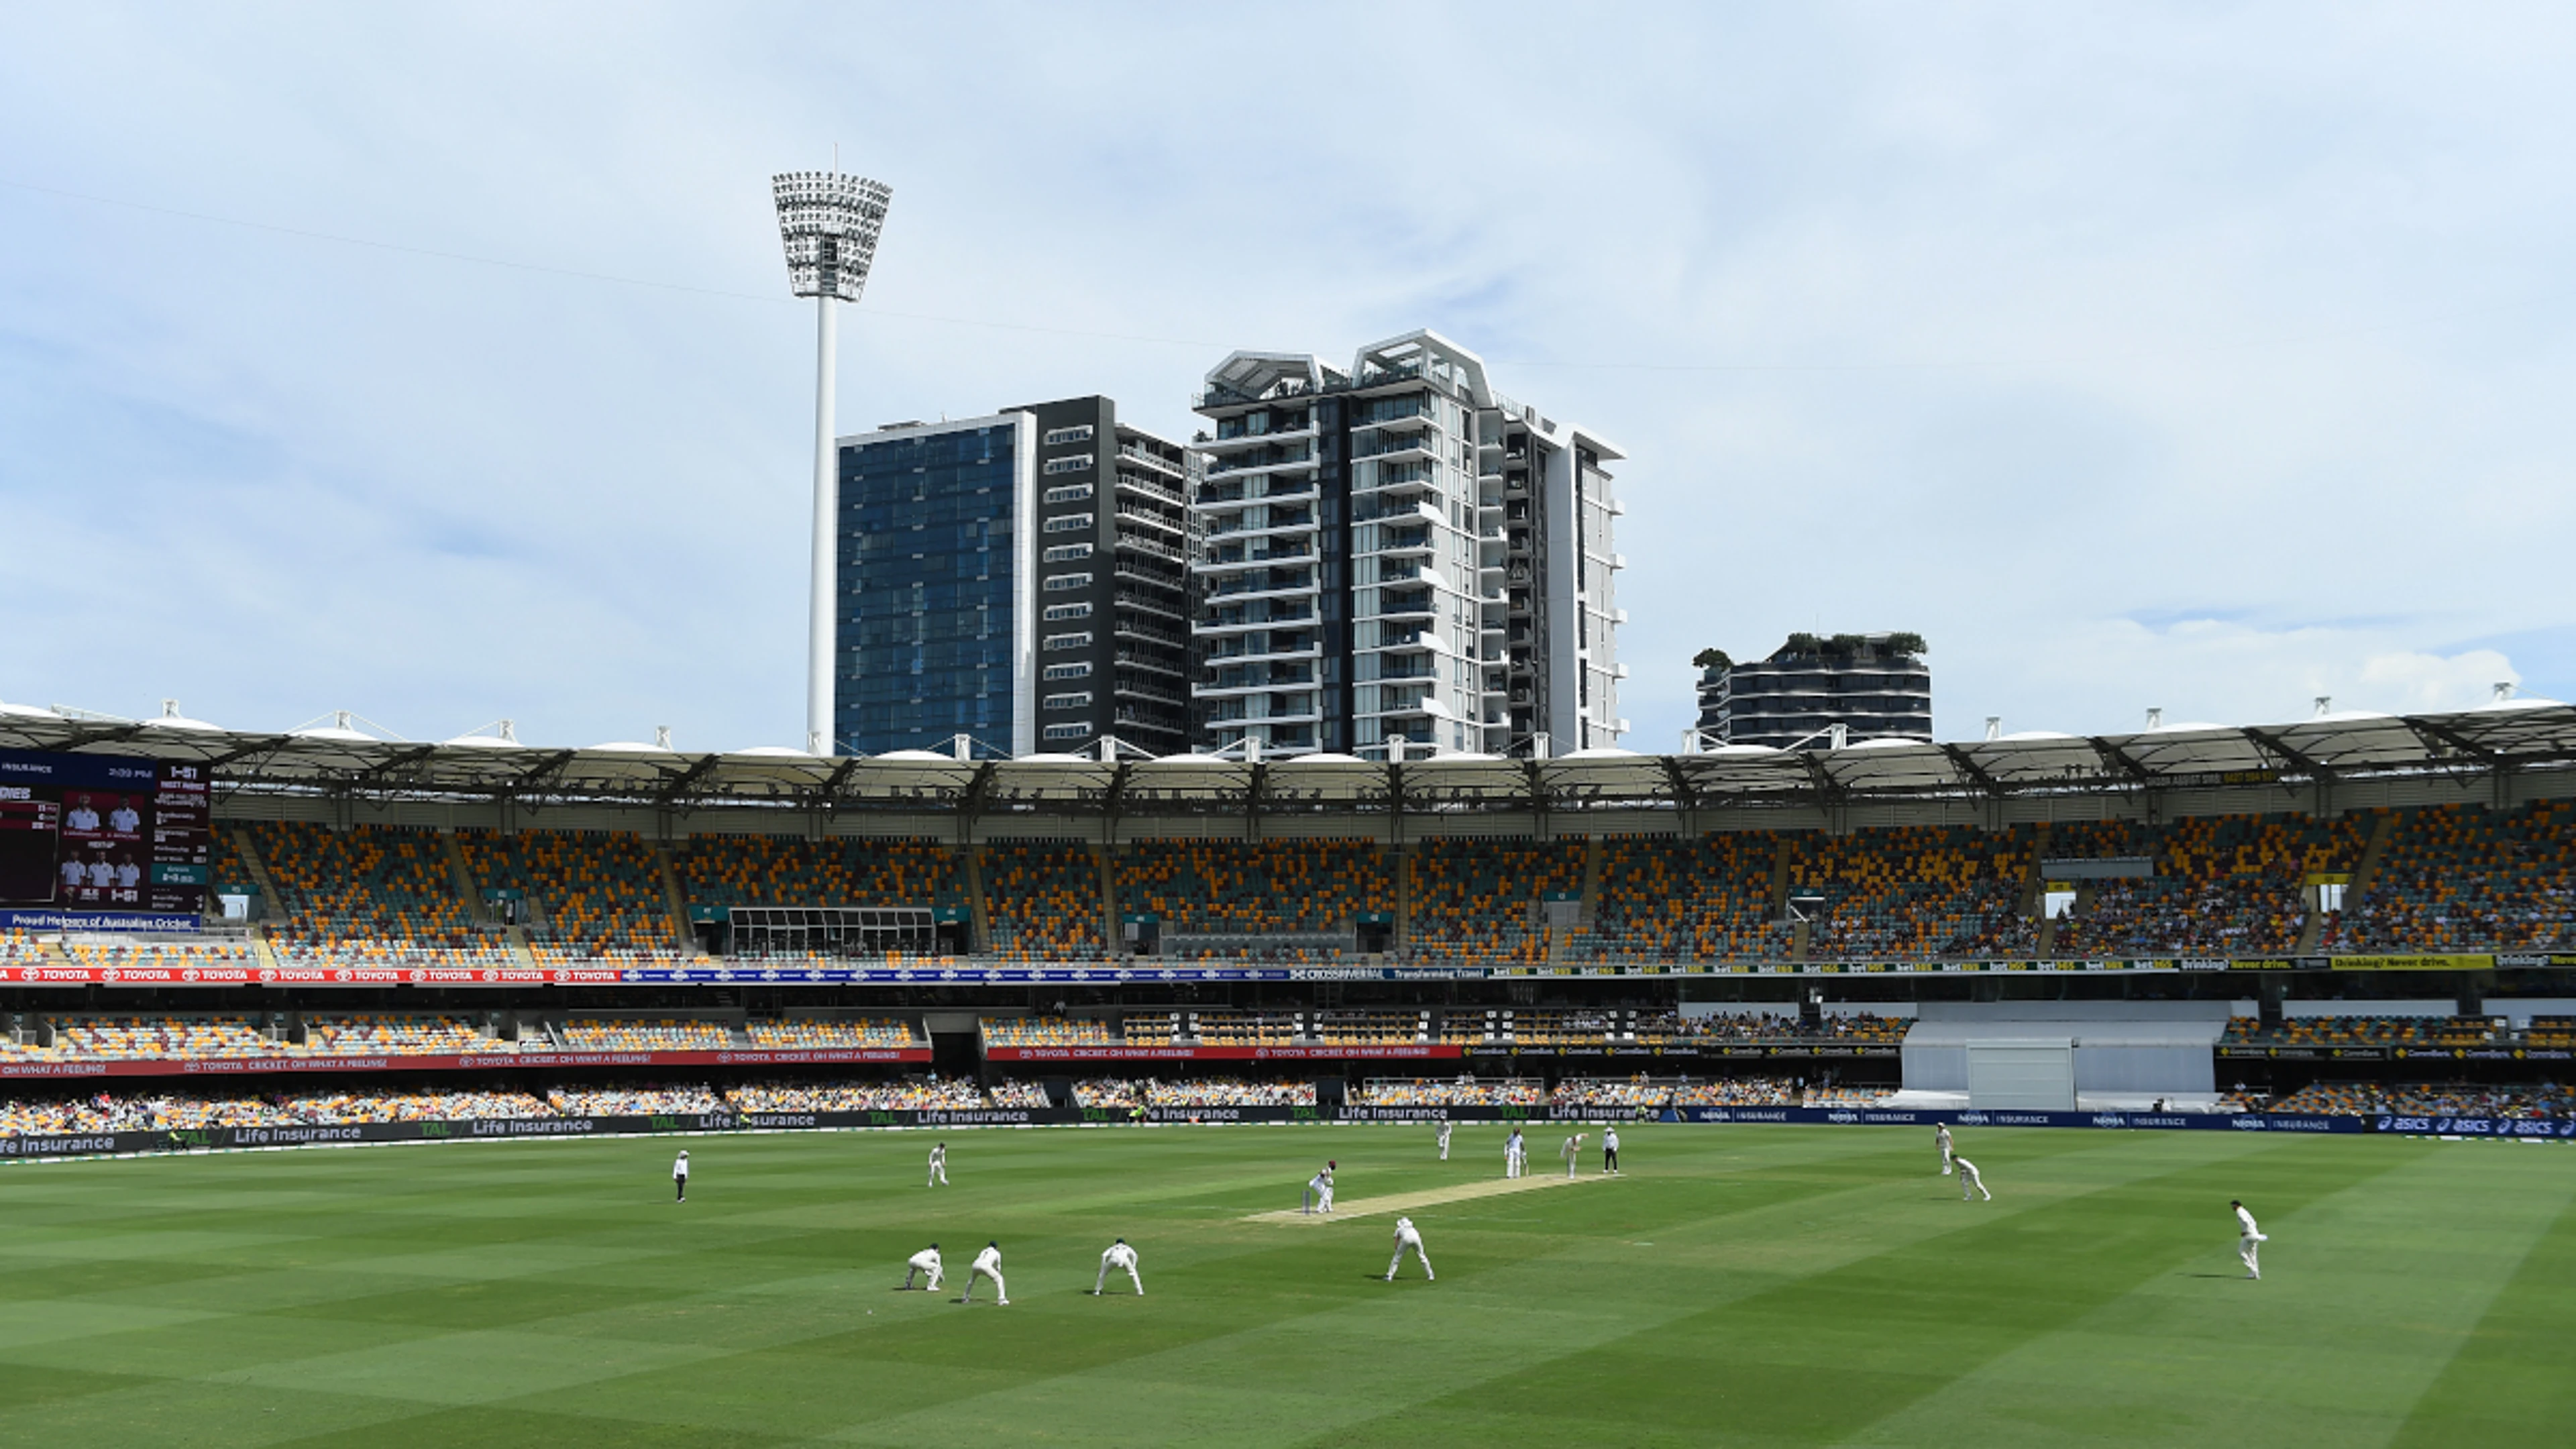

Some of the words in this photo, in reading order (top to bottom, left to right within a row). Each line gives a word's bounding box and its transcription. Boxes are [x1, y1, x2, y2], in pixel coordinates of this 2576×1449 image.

[13, 915, 45, 926] Proud
[90, 916, 99, 926] of
[43, 970, 90, 979] TOYOTA
[123, 970, 170, 979] TOYOTA
[203, 971, 248, 979] TOYOTA
[280, 971, 324, 979] TOYOTA
[356, 971, 398, 979] TOYOTA
[430, 971, 473, 979] TOYOTA
[502, 971, 544, 979] TOYOTA
[574, 971, 616, 979] TOYOTA
[476, 1057, 514, 1065] TOYOTA
[611, 1055, 651, 1063] FEELING!
[734, 1053, 770, 1061] TOYOTA
[2, 1066, 19, 1075] OH
[21, 1065, 52, 1074] WHAT
[54, 1065, 60, 1073] A
[63, 1065, 106, 1073] FEELING!
[309, 1061, 336, 1069] WHAT
[918, 1111, 948, 1124] Life
[951, 1110, 1028, 1124] Insurance
[1081, 1108, 1110, 1121] TAL
[1163, 1108, 1240, 1120] Insurance
[1291, 1107, 1320, 1120] TAL
[1339, 1107, 1368, 1119] Life
[1373, 1107, 1448, 1119] Insurance
[1501, 1106, 1529, 1118] TAL
[1550, 1107, 1578, 1119] Life
[1736, 1112, 1786, 1121] INSURANCE
[649, 1116, 680, 1129] TAL
[700, 1115, 731, 1128] Life
[736, 1114, 816, 1127] Isurance
[868, 1112, 898, 1125] TAL
[1865, 1113, 1915, 1122] INSURANCE
[1996, 1116, 2048, 1124] INSURANCE
[2132, 1118, 2186, 1126] INSURANCE
[419, 1122, 451, 1136] TAL
[473, 1121, 505, 1134] Life
[510, 1118, 593, 1132] Insurance
[2273, 1120, 2330, 1130] INSURANCE
[178, 1131, 212, 1145] TAL
[235, 1128, 268, 1142] Life
[273, 1128, 362, 1141] Insurance
[22, 1137, 115, 1152] Insurance
